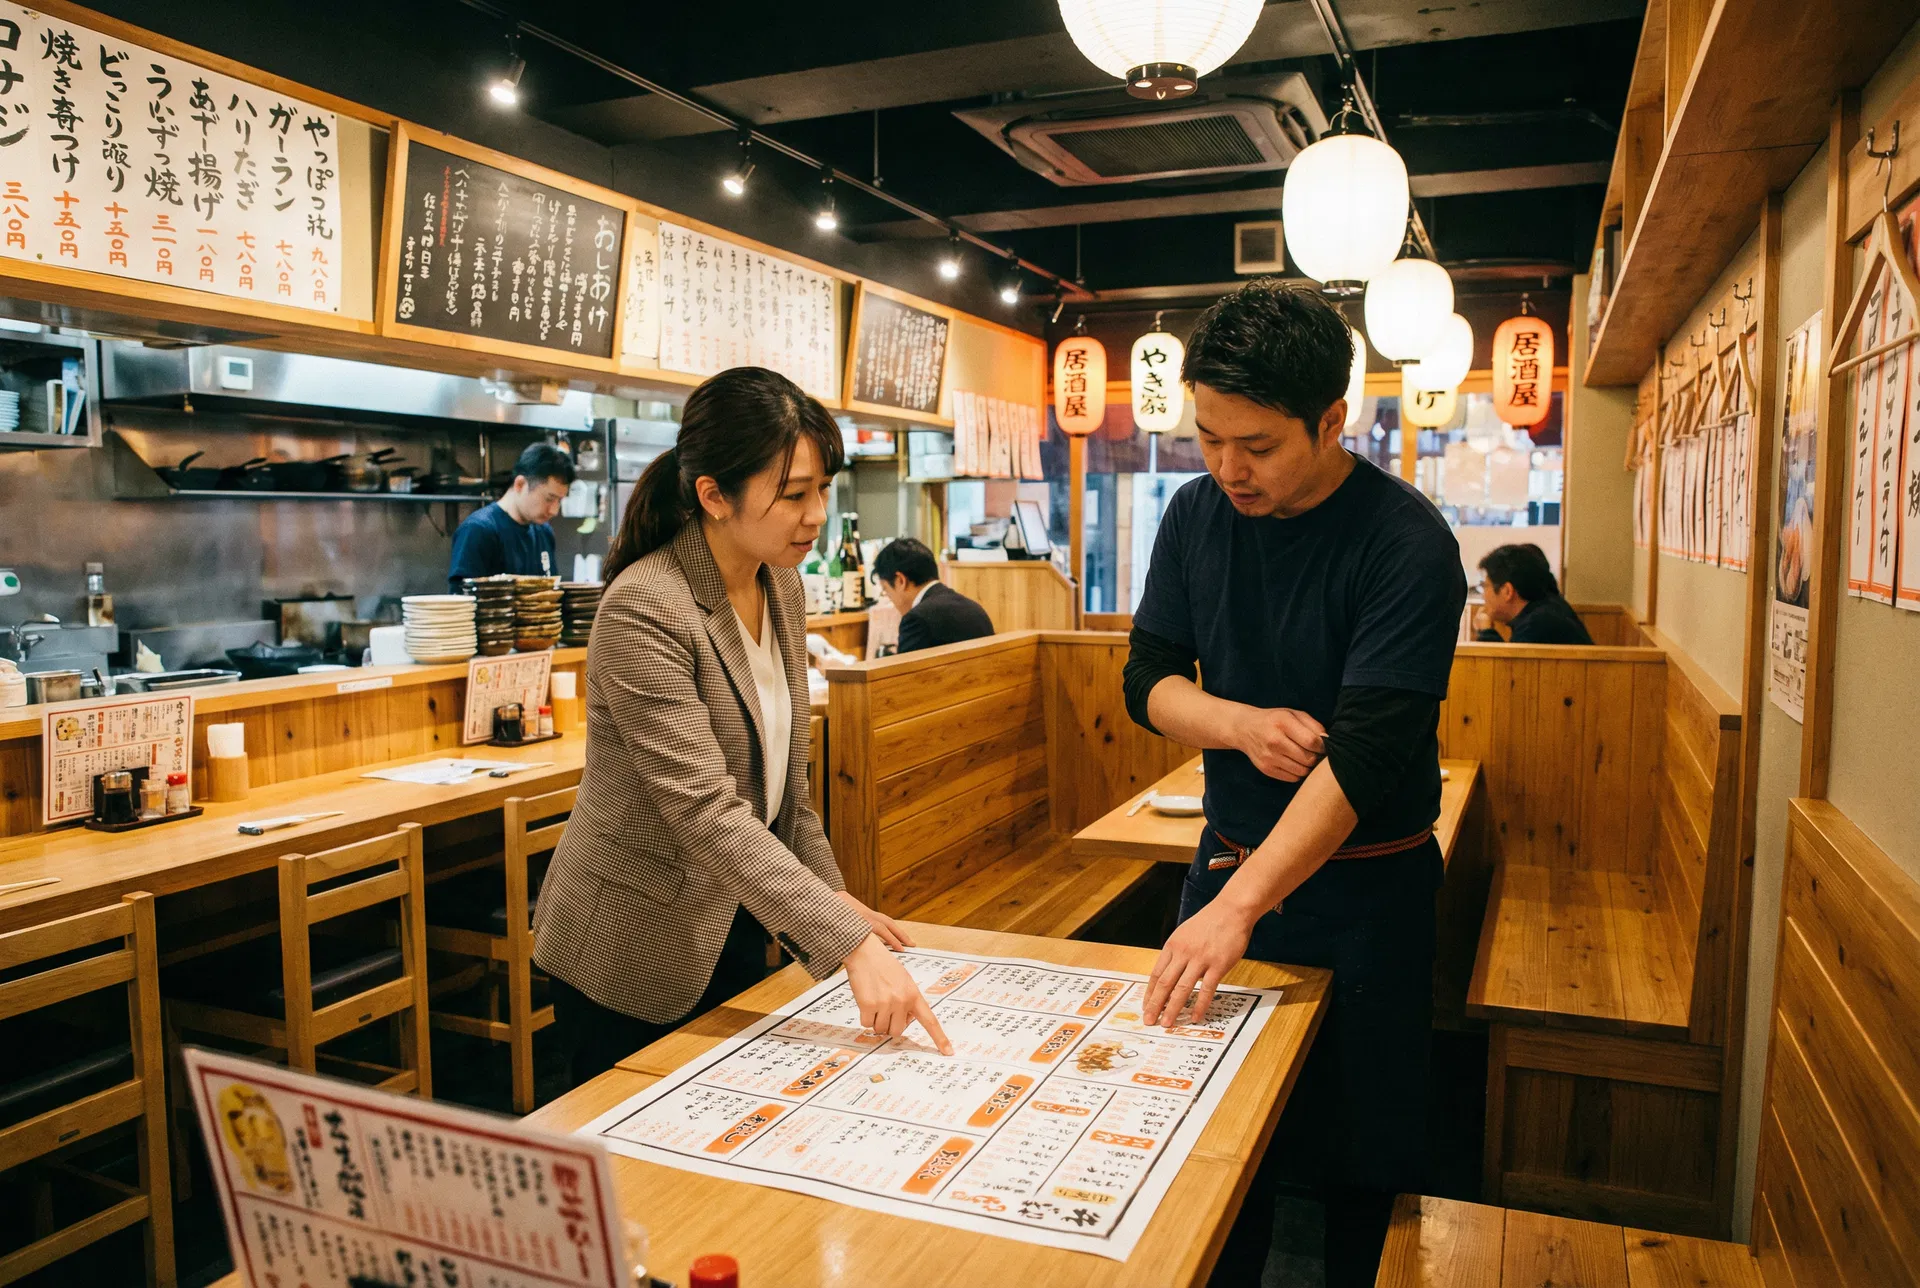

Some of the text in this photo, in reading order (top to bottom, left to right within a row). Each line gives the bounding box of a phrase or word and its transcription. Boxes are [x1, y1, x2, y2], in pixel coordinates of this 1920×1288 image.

[1064, 349, 1088, 417] 居酒屋
[1508, 332, 1539, 407] 居酒屋
